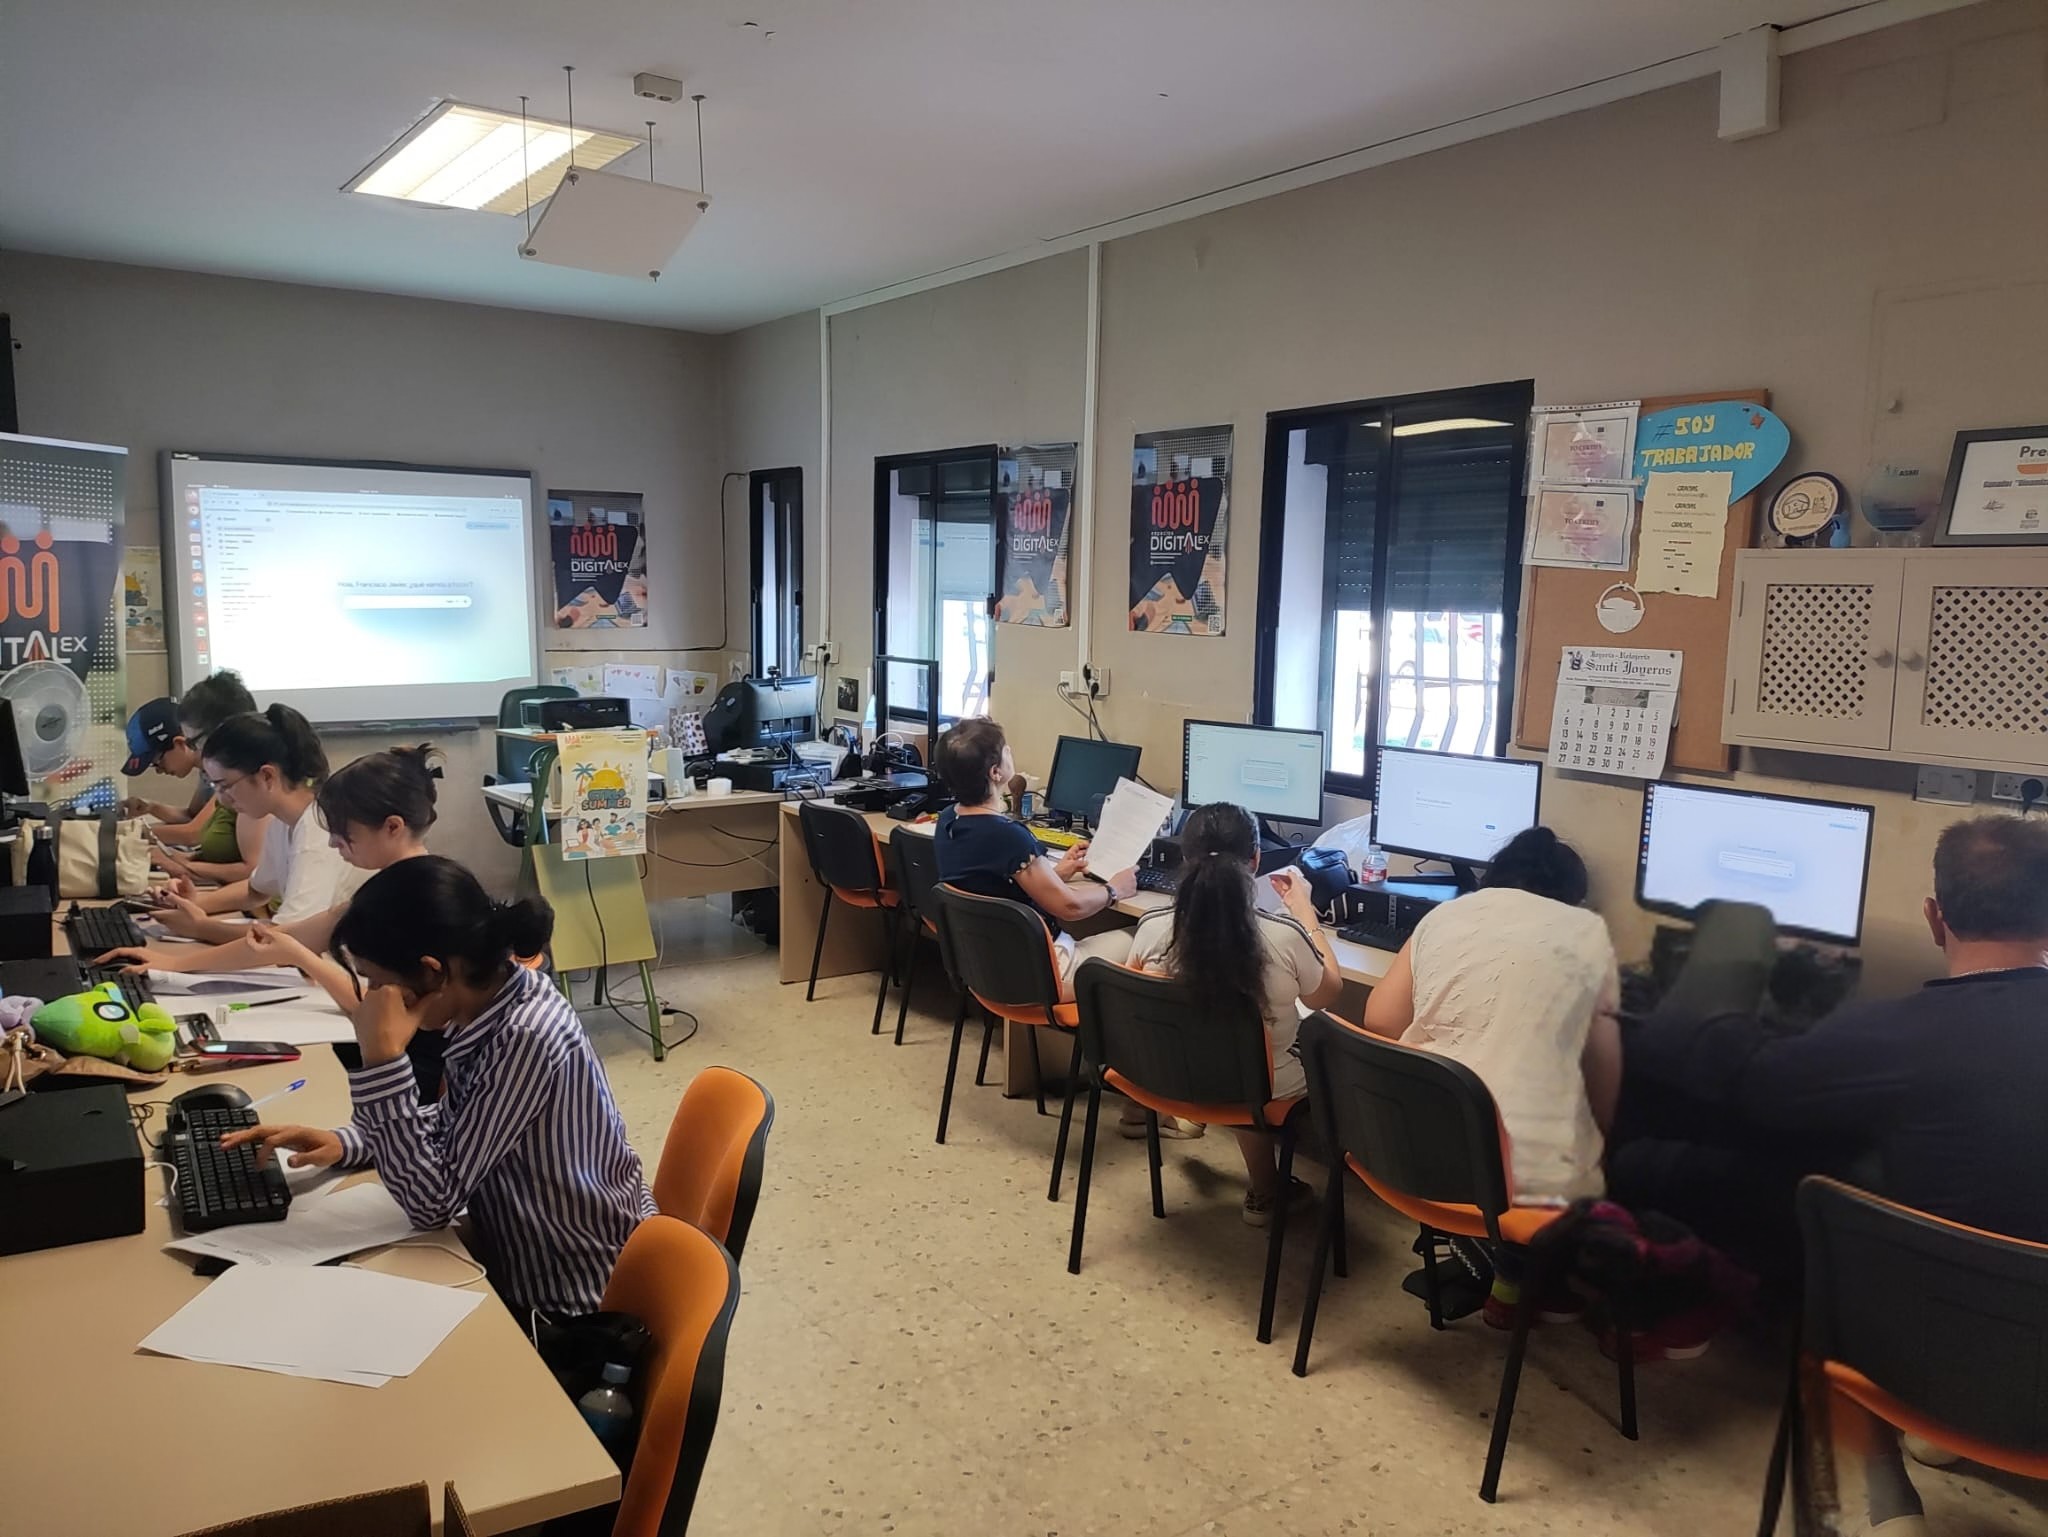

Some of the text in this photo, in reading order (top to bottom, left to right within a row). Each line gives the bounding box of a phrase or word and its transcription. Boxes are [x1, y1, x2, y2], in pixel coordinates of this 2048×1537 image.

[1640, 442, 1756, 468] TRABAJADOR
[2020, 446, 2048, 458] Pre
[1585, 658, 1672, 676] Santi Joyeros
[1623, 722, 1629, 731] 10
[1652, 725, 1657, 733] 12
[1562, 729, 1656, 746] 13 14 15 16 17 18 19
[1560, 742, 1568, 750] 20
[1589, 745, 1597, 753] 22
[1604, 746, 1611, 755] 23
[1618, 748, 1626, 756] 24
[1633, 750, 1640, 758] 25
[1647, 751, 1654, 760] 26
[1573, 756, 1580, 764] 28
[1587, 758, 1595, 766] 29
[1602, 759, 1610, 767] 30
[1617, 761, 1624, 770] 31
